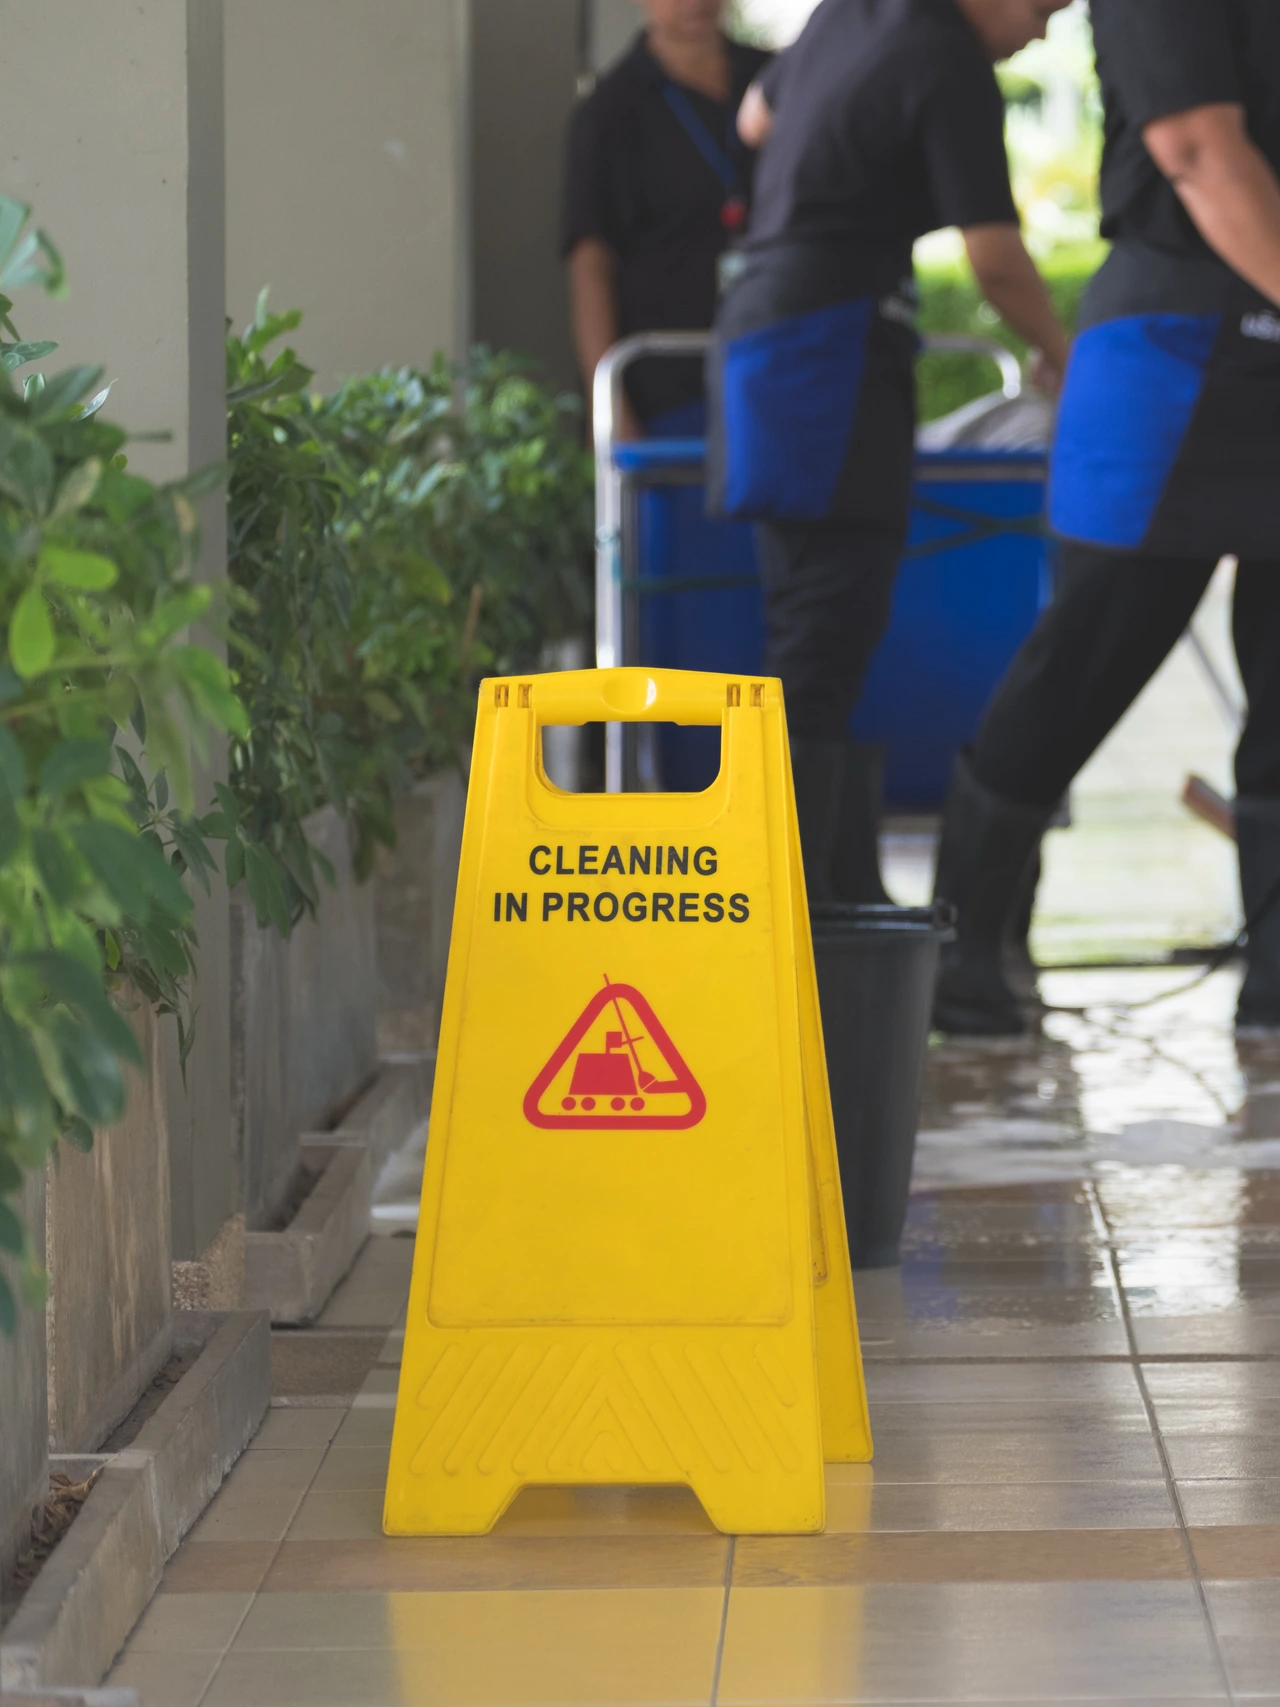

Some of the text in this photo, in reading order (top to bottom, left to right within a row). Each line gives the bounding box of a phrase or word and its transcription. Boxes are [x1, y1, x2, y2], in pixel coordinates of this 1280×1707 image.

[529, 845, 718, 876] CLEANING
[493, 892, 750, 923] IN PROGRESS
